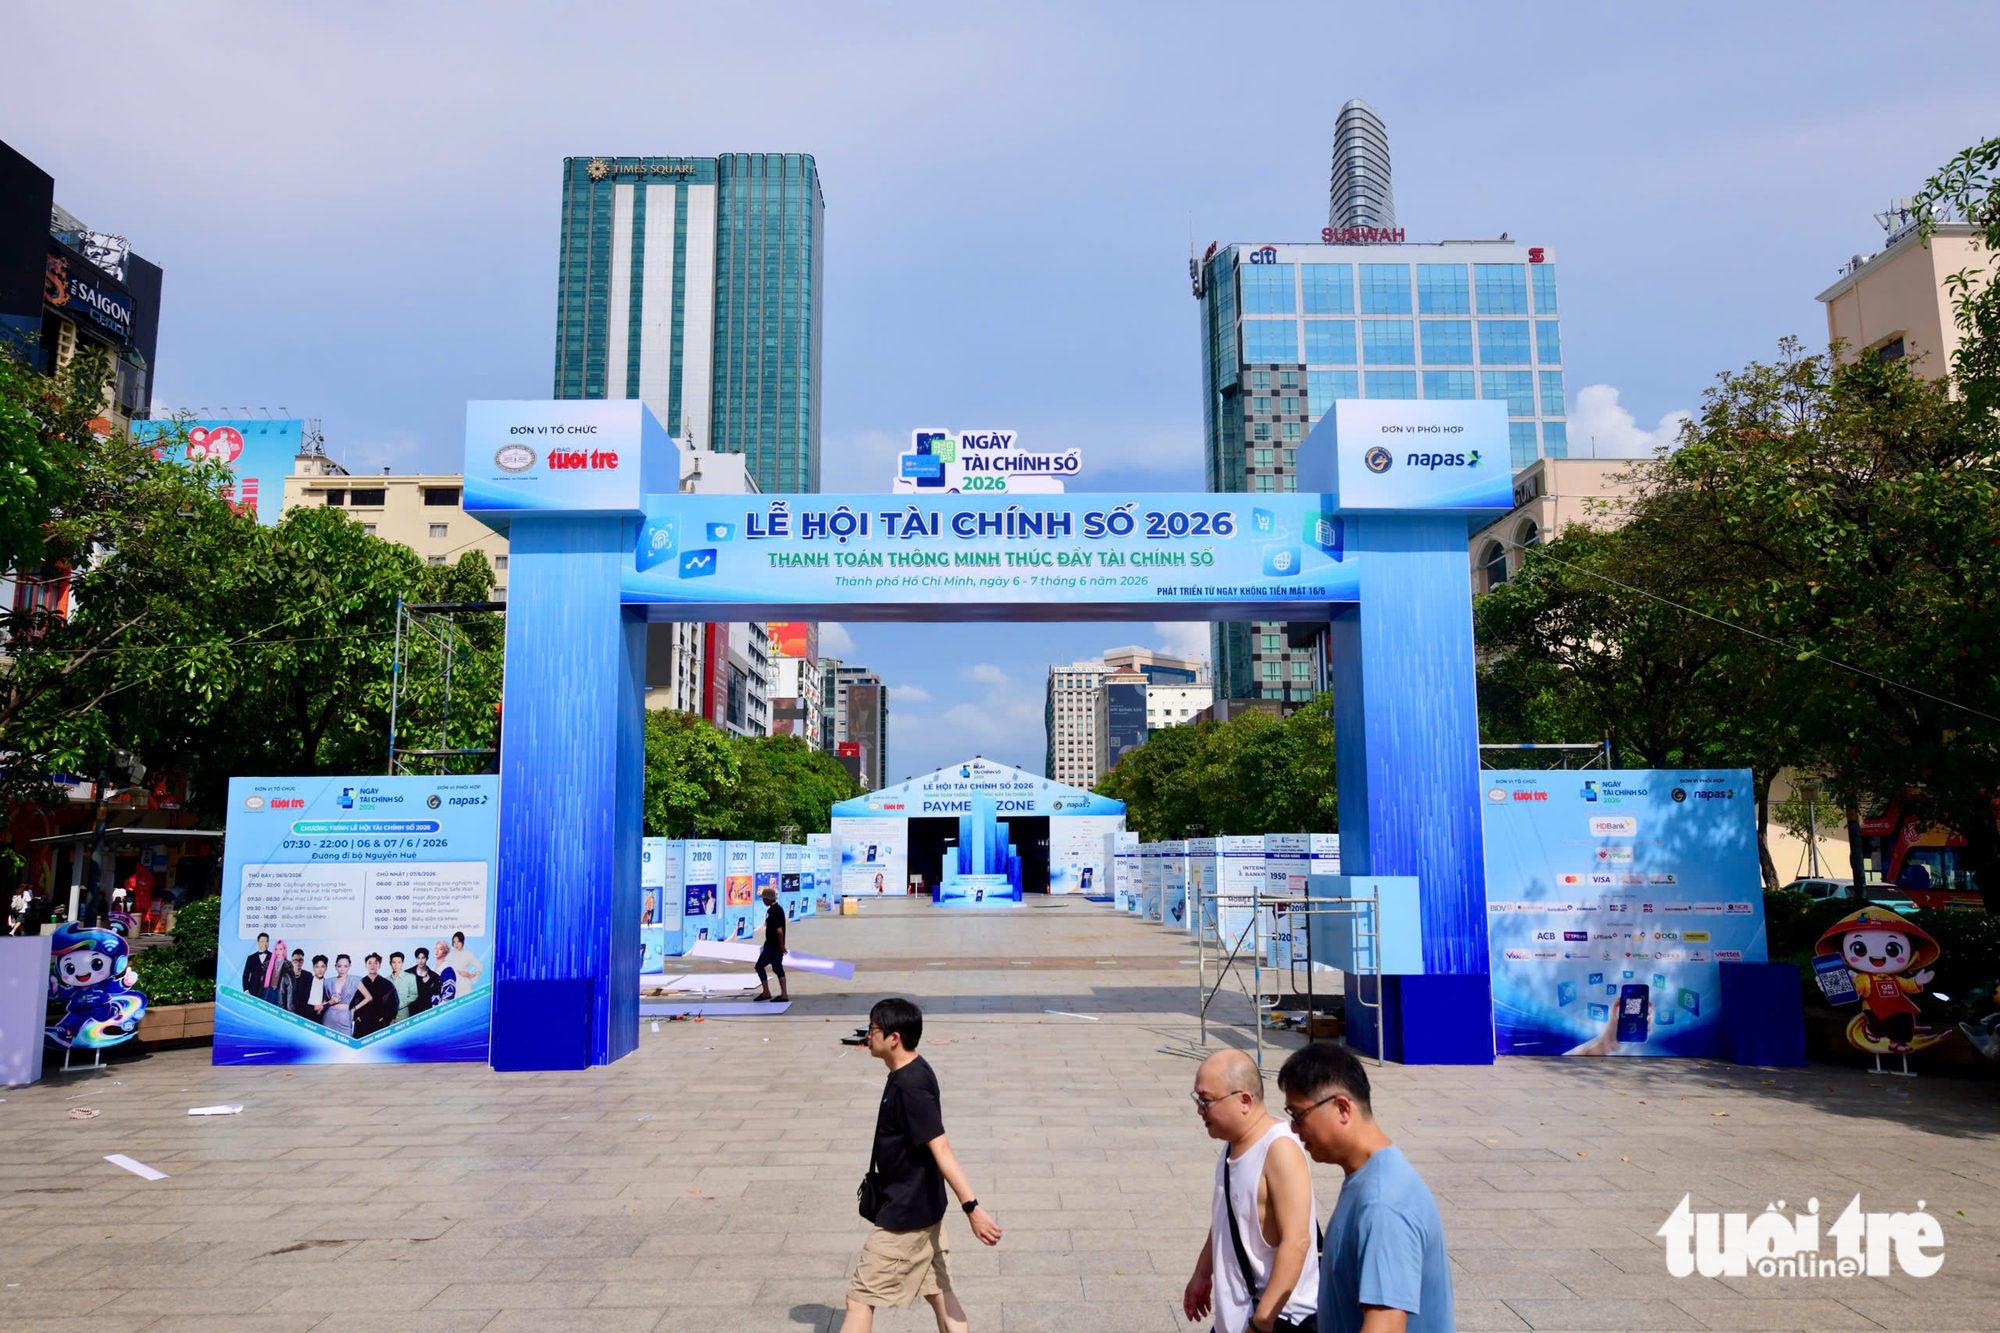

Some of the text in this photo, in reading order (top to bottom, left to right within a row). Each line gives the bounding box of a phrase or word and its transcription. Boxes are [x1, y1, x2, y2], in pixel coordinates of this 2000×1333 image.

[614, 164, 696, 174] TIMES SQUARE
[1322, 227, 1405, 242] SUNWAH
[1250, 246, 1277, 264] citi
[78, 282, 130, 326] SAIGON
[510, 423, 598, 436] ĐƠN VỊ TỔ CHỨC
[1406, 426, 1414, 434] VỊ
[1418, 424, 1440, 433] PHỐI
[1444, 426, 1464, 435] HỢP
[962, 432, 1012, 449] NGÀY
[590, 448, 618, 470] trẻ
[962, 452, 1079, 471] TÀI CHÍNH SỐ
[1406, 453, 1464, 470] napas
[962, 476, 1006, 490] 2026
[746, 500, 1236, 545] LỄ HỘI TÀI CHÍNH SỐ 2026
[768, 547, 1214, 567] THANH TOÁN THÔNG MINH THÚC ĐẨY TÀI CHÍNH SỐ
[836, 576, 1148, 588] Thành phố Hồ Chí Minh, ngày 6 7 tháng 6 năm 2026
[1157, 586, 1177, 596] PHÁT
[1180, 584, 1202, 596] TRIỂN
[1205, 586, 1215, 596] TỪ
[1217, 586, 1238, 596] NGÀY
[1240, 586, 1267, 596] KHÔNG
[1270, 584, 1287, 596] TIỀN
[1290, 586, 1306, 597] MẶT
[924, 782, 934, 790] LỄ
[1000, 781, 1012, 790] SỐ
[448, 796, 480, 807] napas
[1694, 790, 1726, 800] napas
[924, 800, 1034, 812] PAYME ZONE
[283, 840, 310, 848] 07:30
[320, 840, 348, 848] 22:00
[357, 840, 370, 848] 06
[374, 840, 380, 848] &
[384, 840, 396, 848] 07
[423, 839, 448, 847] 2026
[312, 852, 340, 860] Đường
[352, 852, 362, 860] bộ
[366, 851, 398, 860] Nguyễn
[400, 852, 416, 860] Huệ
[692, 852, 712, 861] 2020
[732, 852, 747, 860] 2021
